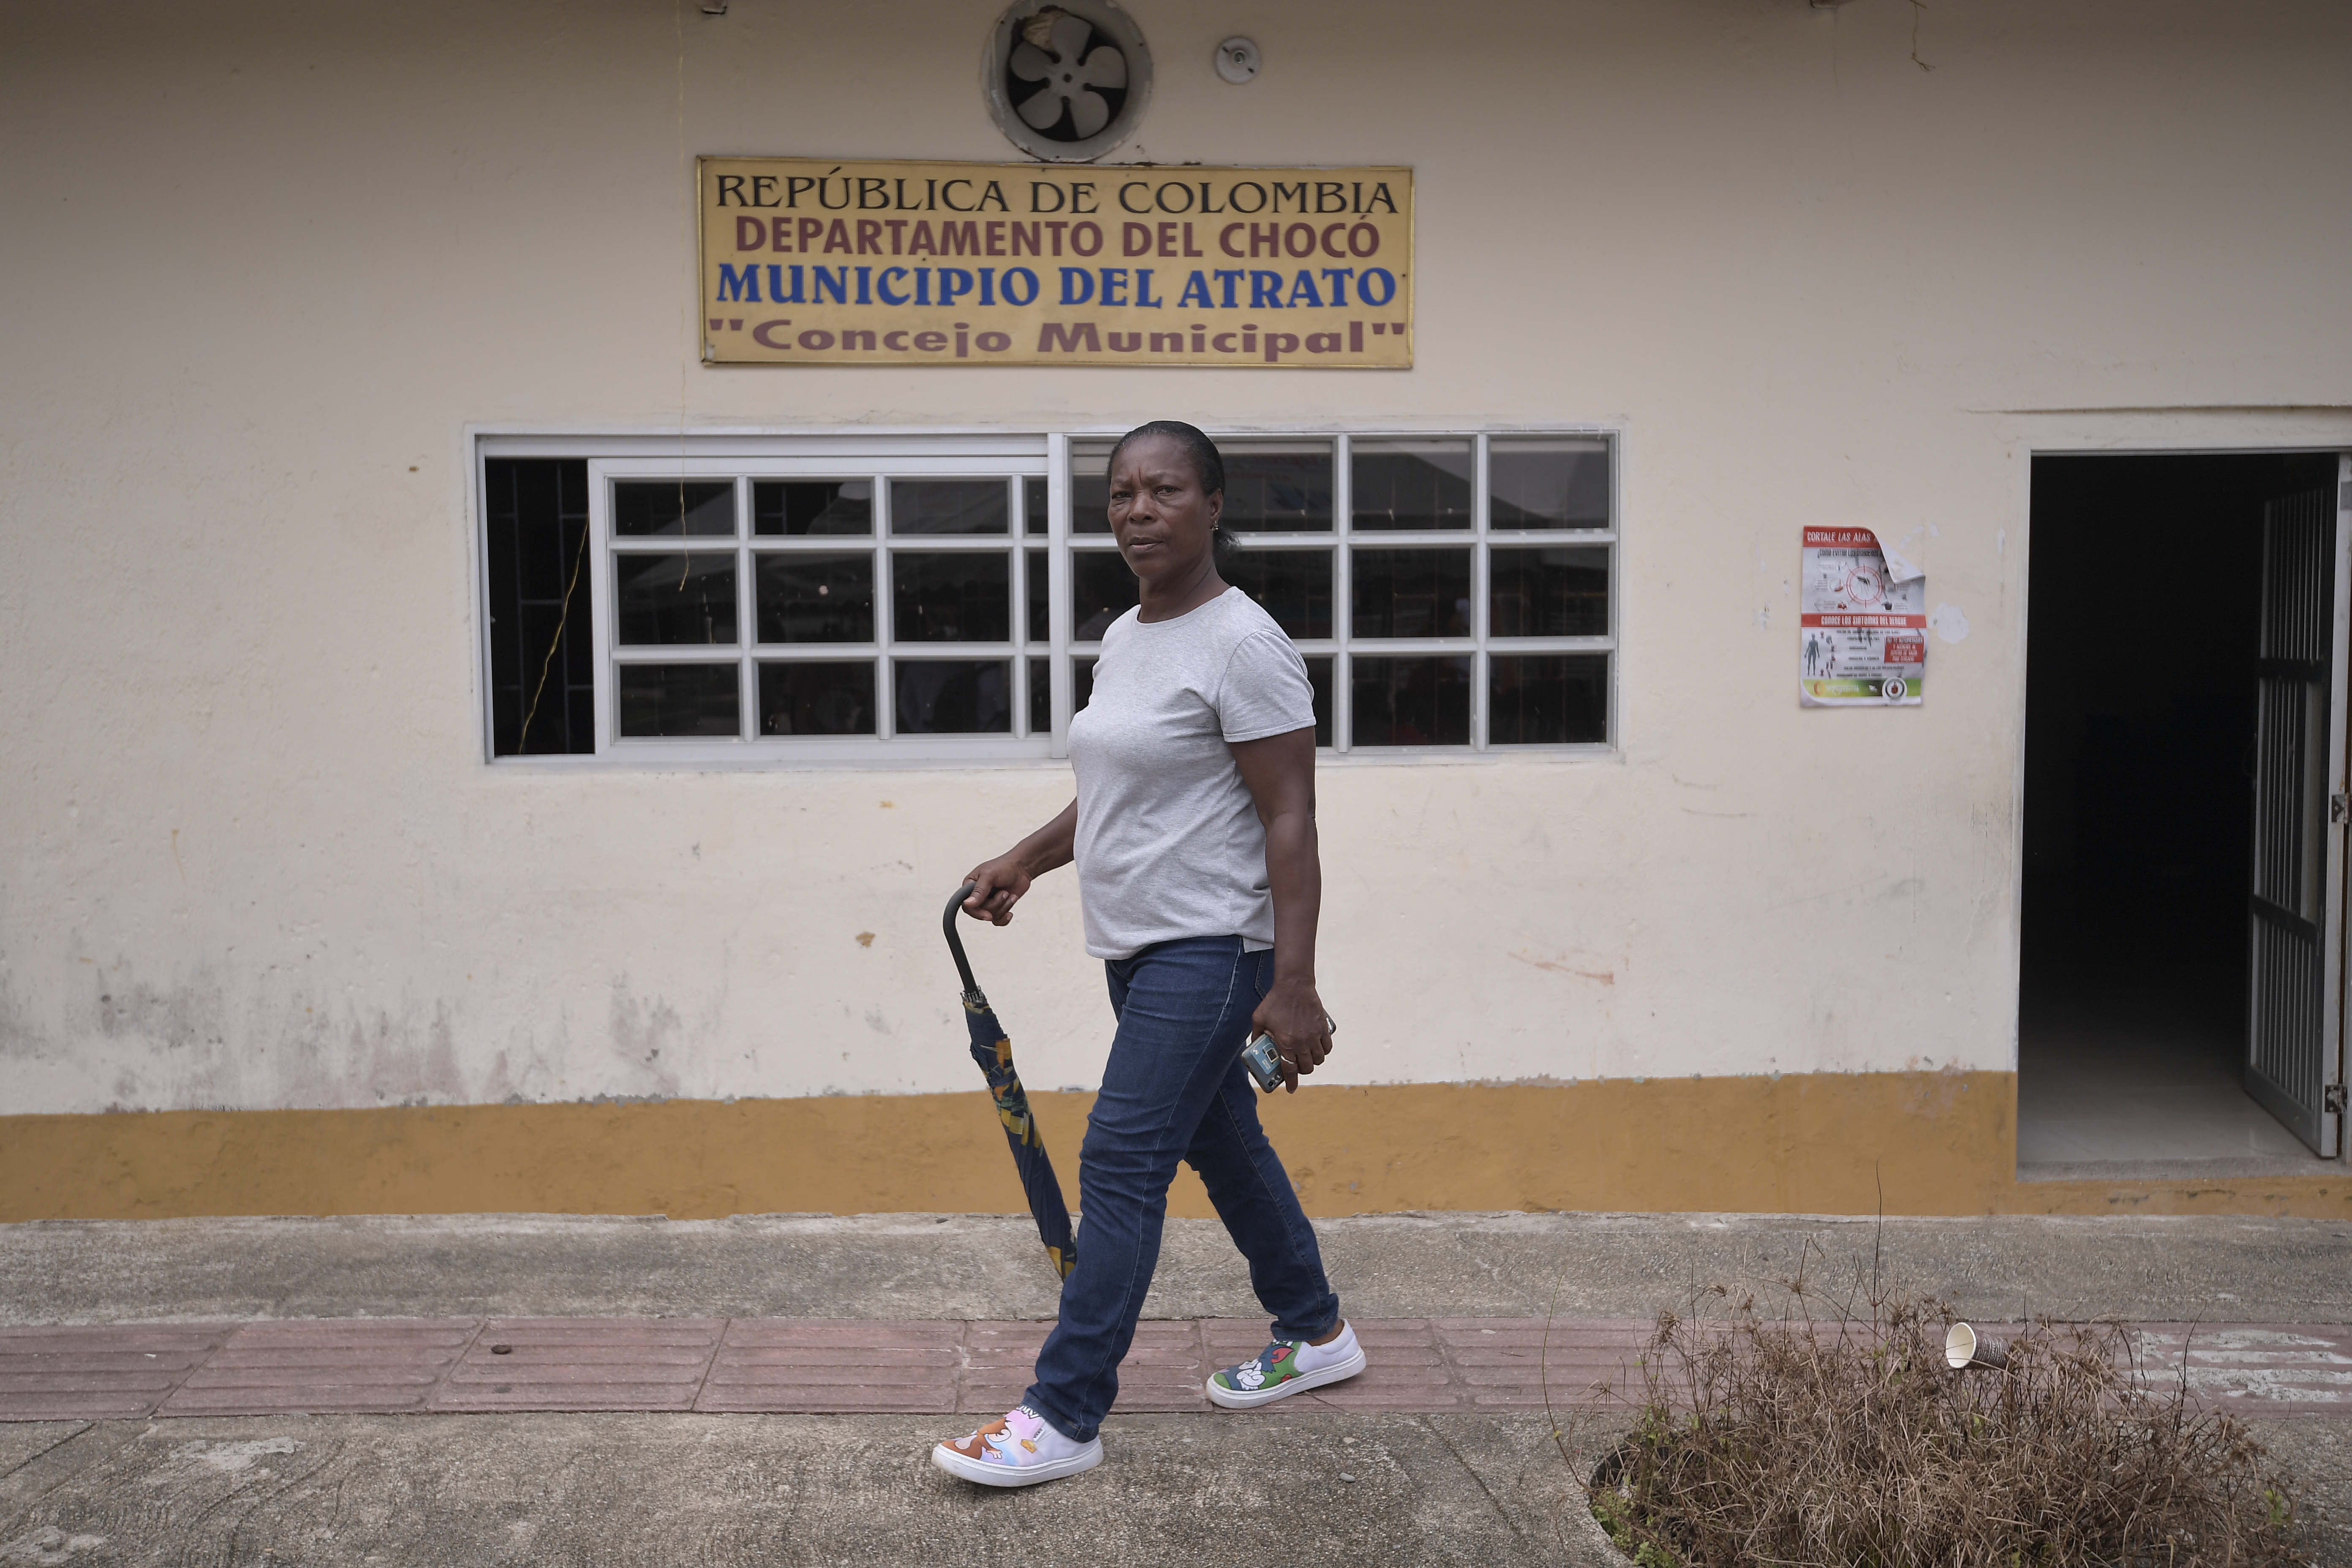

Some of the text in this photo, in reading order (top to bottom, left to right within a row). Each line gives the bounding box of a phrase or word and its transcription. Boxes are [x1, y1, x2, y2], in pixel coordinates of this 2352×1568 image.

[717, 166, 1399, 215] REPÚBLICA DE COLOMBIA
[736, 215, 1380, 258] DEPARTAMENTO DEL CHOCÓ
[716, 263, 1396, 309] MUNICIPIO DEL ATRATO
[709, 318, 1405, 362] "Concejo Municipal"
[1807, 531, 1836, 542] CORTALE
[1838, 532, 1851, 542] LAS
[1853, 532, 1871, 542] ALAS
[1821, 615, 1840, 625] CONOCE
[1842, 615, 1851, 625] LOS
[1880, 616, 1888, 625] DEL
[1889, 616, 1906, 626] DENGUE
